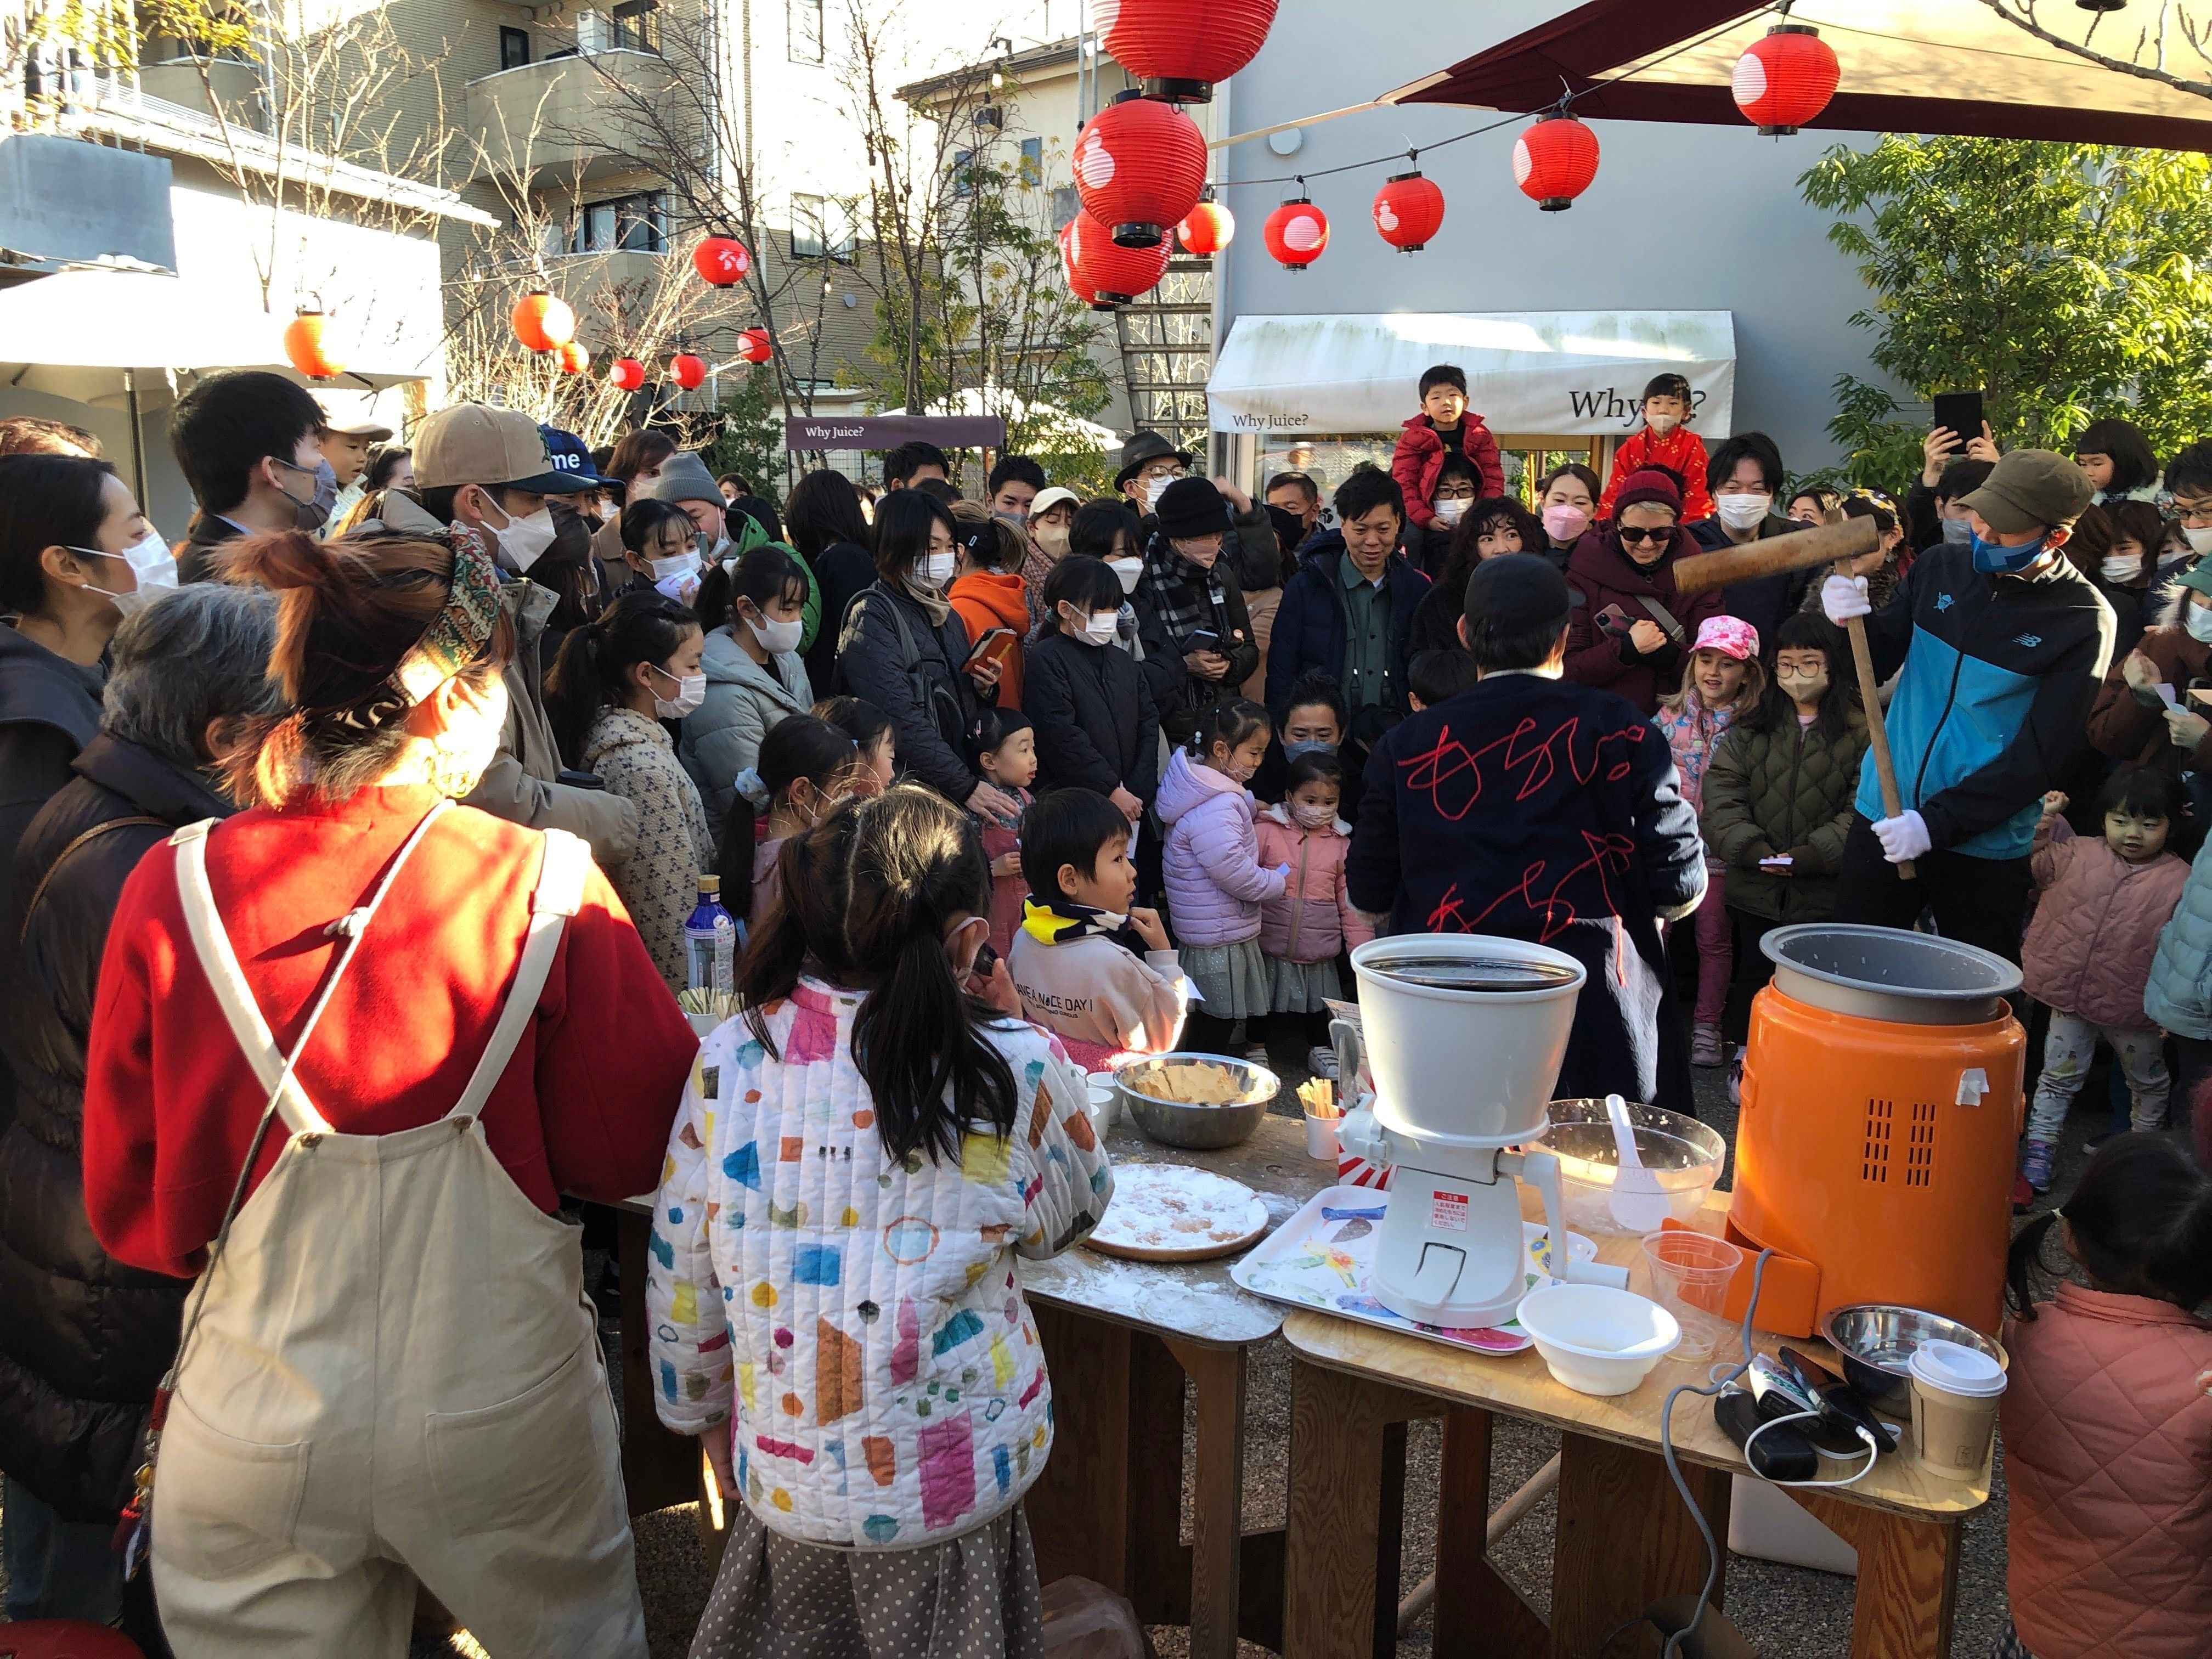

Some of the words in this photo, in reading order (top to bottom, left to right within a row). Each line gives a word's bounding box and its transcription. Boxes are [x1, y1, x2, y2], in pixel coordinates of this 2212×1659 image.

[1568, 387, 1645, 427] Why
[1233, 414, 1265, 431] Why
[1267, 414, 1309, 429] Juice?
[805, 426, 831, 440] Why
[832, 426, 865, 439] Juice?
